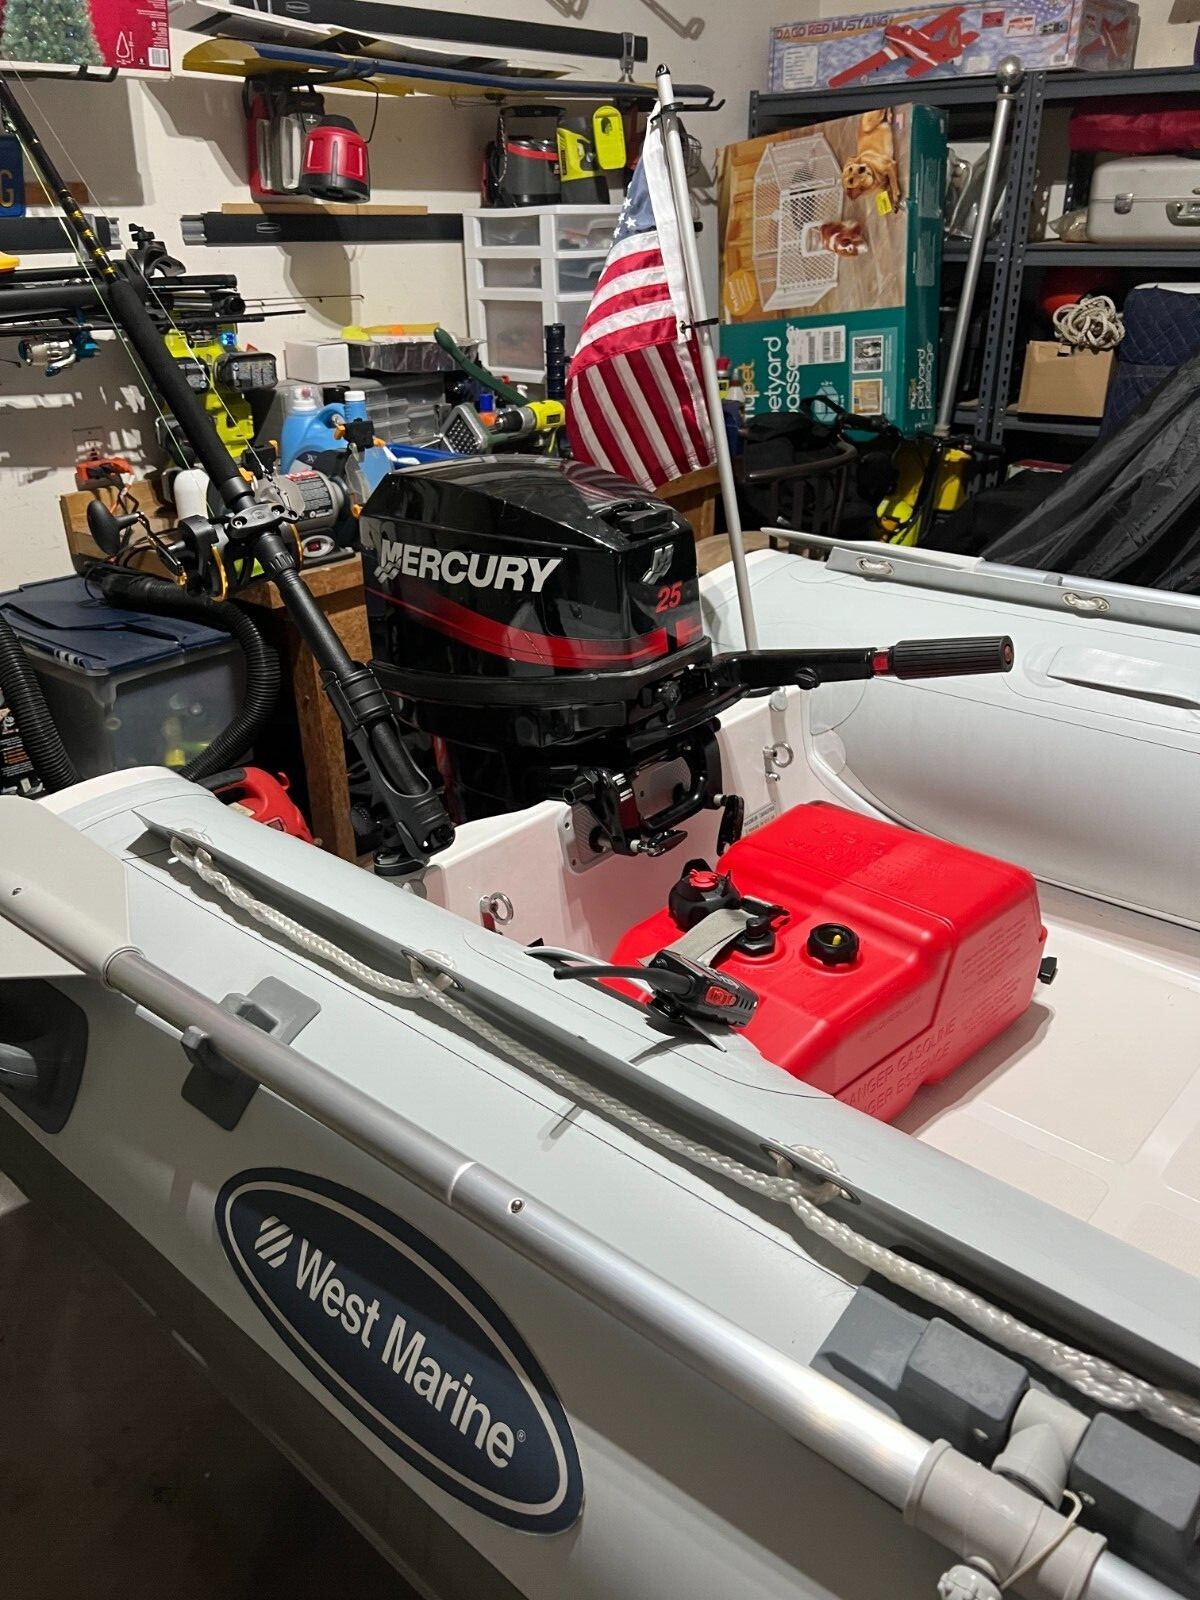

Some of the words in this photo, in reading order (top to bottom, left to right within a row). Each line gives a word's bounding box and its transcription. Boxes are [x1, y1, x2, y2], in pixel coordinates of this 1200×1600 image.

[763, 336, 783, 412] etyard
[378, 539, 563, 593] MERCURY
[655, 580, 683, 614] 25
[296, 1238, 381, 1349] West
[380, 1312, 516, 1469] Marine
